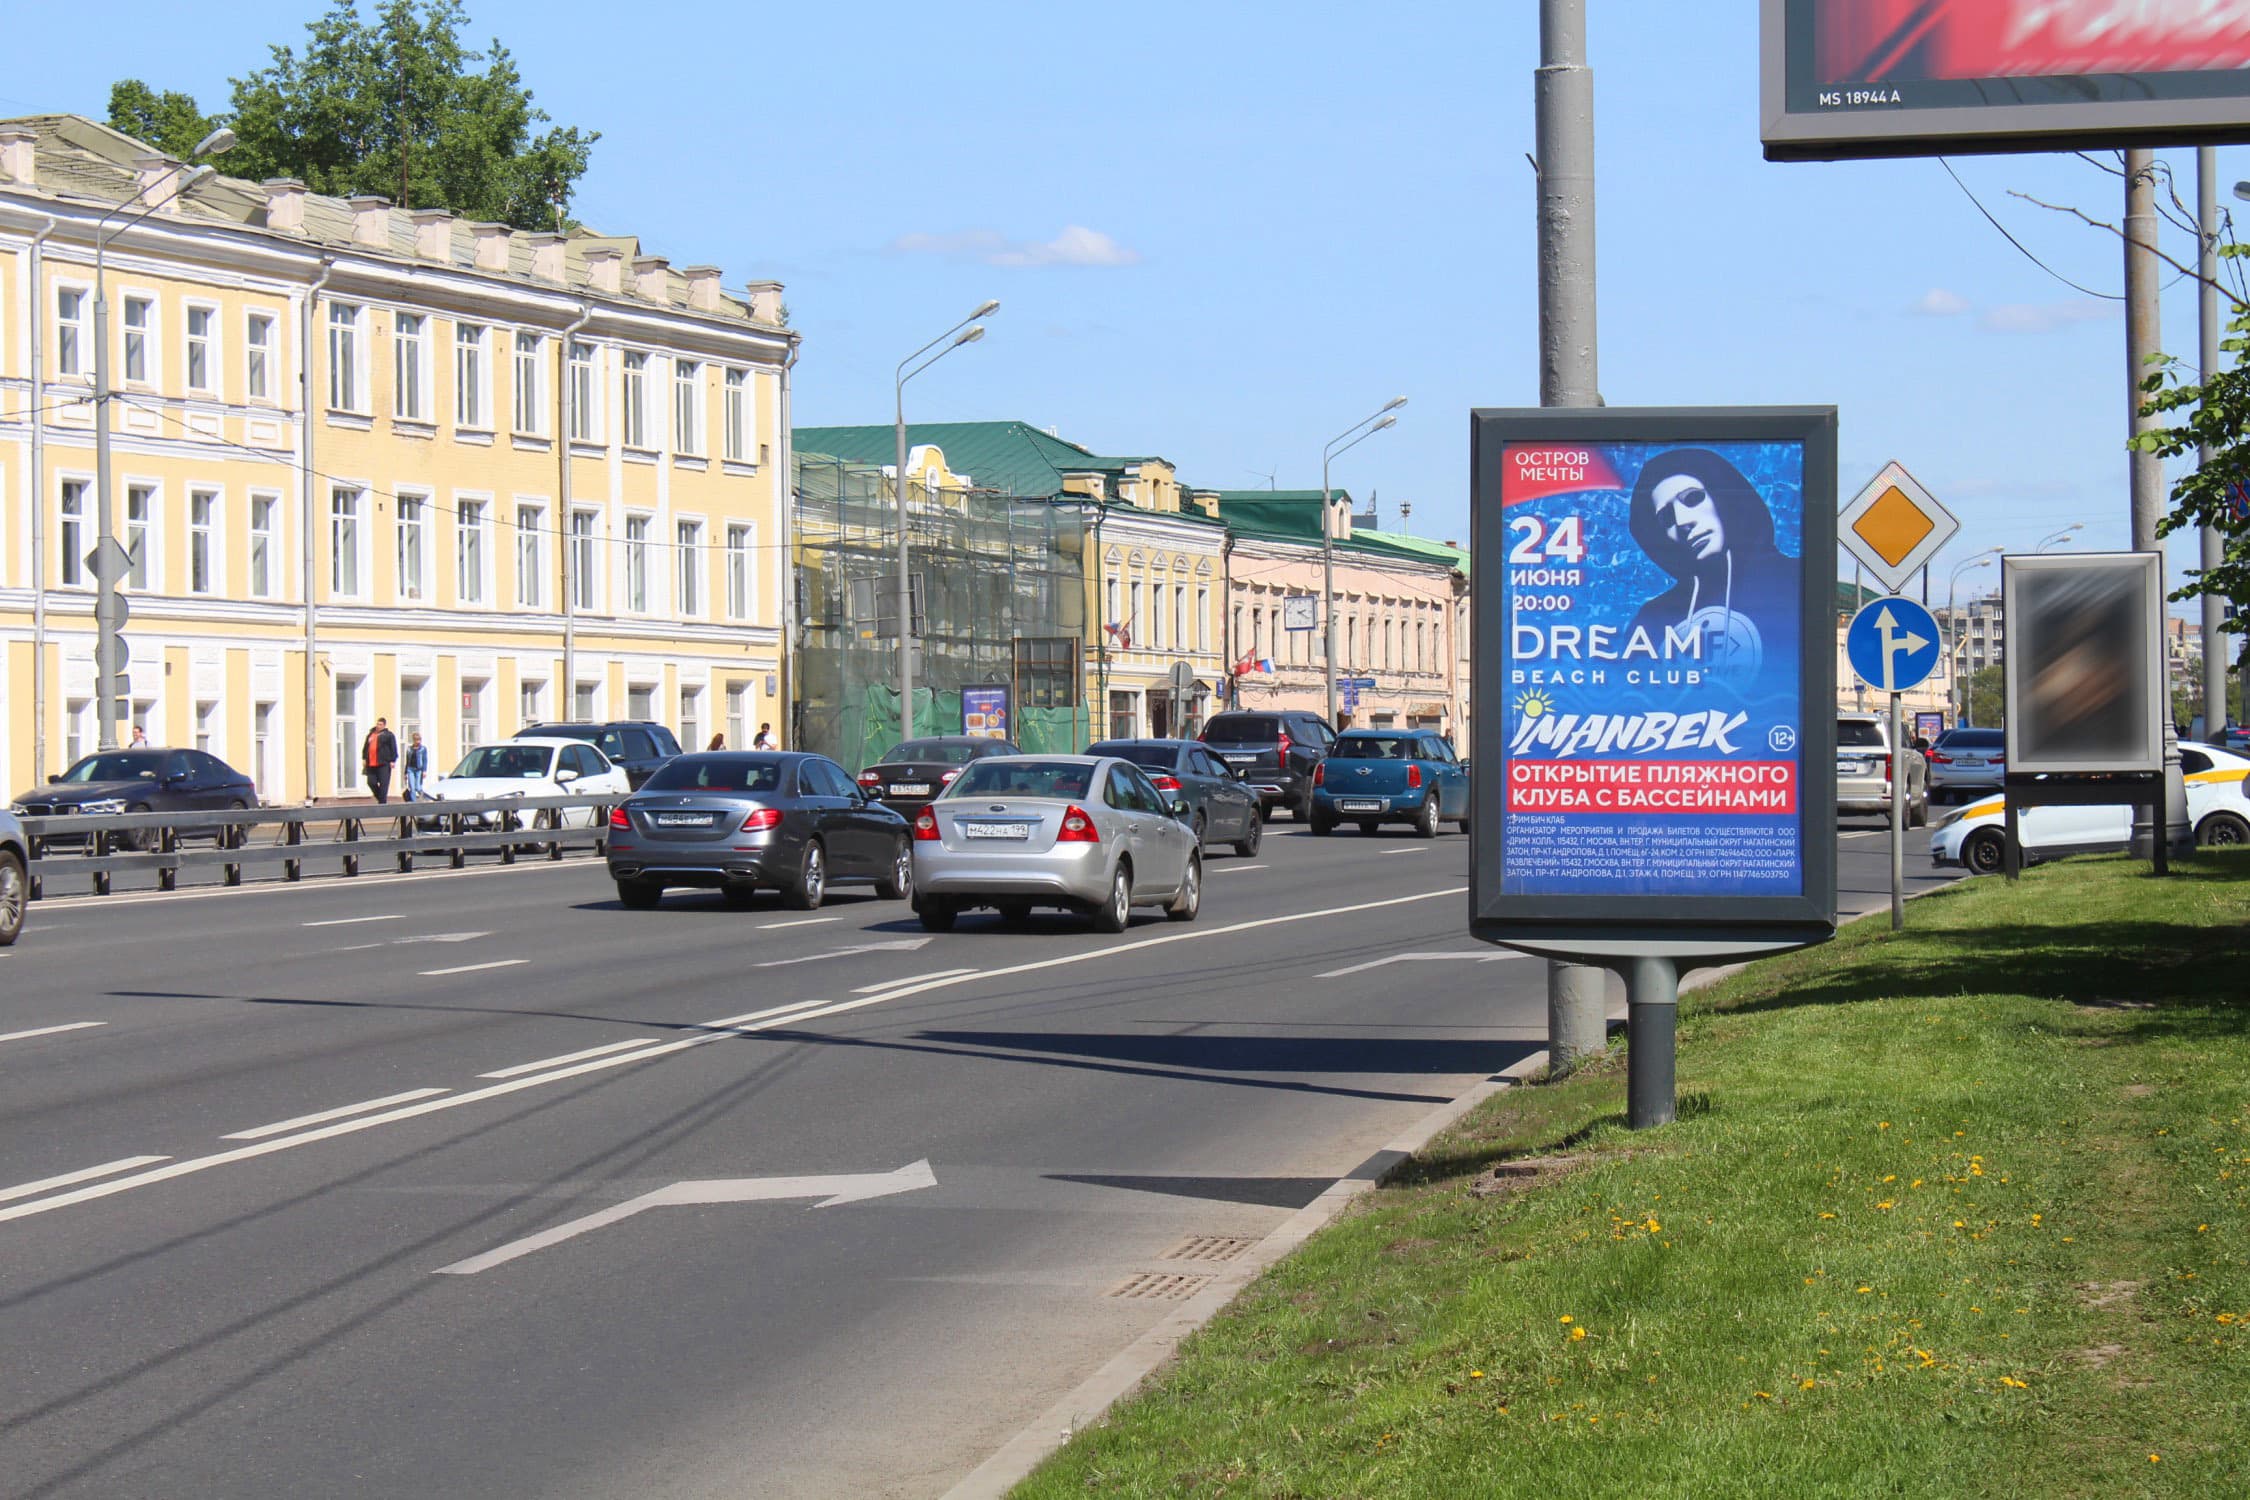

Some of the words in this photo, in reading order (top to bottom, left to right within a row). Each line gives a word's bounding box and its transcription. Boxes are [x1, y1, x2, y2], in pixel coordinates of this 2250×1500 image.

[1819, 93, 1841, 106] MS
[1846, 91, 1887, 105] 18944
[1890, 90, 1901, 103] A
[1515, 451, 1589, 466] ОСТРОВ
[1520, 467, 1584, 481] МЕЧТЫ
[1509, 515, 1583, 564] 24
[1510, 569, 1580, 587] ИЮНЯ
[1512, 595, 1570, 611] 20:00
[1511, 624, 1701, 660] DREAM
[1511, 669, 1606, 685] BEACH
[1773, 731, 1794, 746] 12+
[1512, 765, 1641, 783] ОТКРЫТИЕ
[1647, 765, 1789, 784] ПЛЯЖНОГО
[1513, 788, 1591, 807] КЛУБА
[1595, 788, 1611, 807] С
[1617, 784, 1787, 807] БАССЕЙНАМИ
[1531, 816, 1545, 824] БИЧ
[1546, 816, 1565, 824] КЛАБ
[1506, 827, 1556, 835] ОРГАНИЗАТОР
[1560, 827, 1613, 835] МЕРОПРИЯТИЯ
[1628, 827, 1663, 835] ПРОДАЖА
[1667, 827, 1700, 835] БИЛЕТОВ
[1704, 827, 1773, 835] ОСУЩЕСТВЛЯЮТСЯ
[1652, 837, 1718, 846] МУНИЦИПАЛЬНЫЙ
[1720, 838, 1741, 846] ОКРУГ
[1743, 838, 1795, 846] НАГАТИНСКИЙ
[1652, 858, 1718, 867] МУНИЦИПАЛЬНЫЙ
[1720, 859, 1741, 867] ОКРУГ
[1743, 858, 1795, 868] НАГАТИНСКИЙ
[1536, 869, 1559, 878] ПР-КТ
[1629, 869, 1651, 878] ЭТАЖ
[1709, 870, 1731, 878] ОГРН
